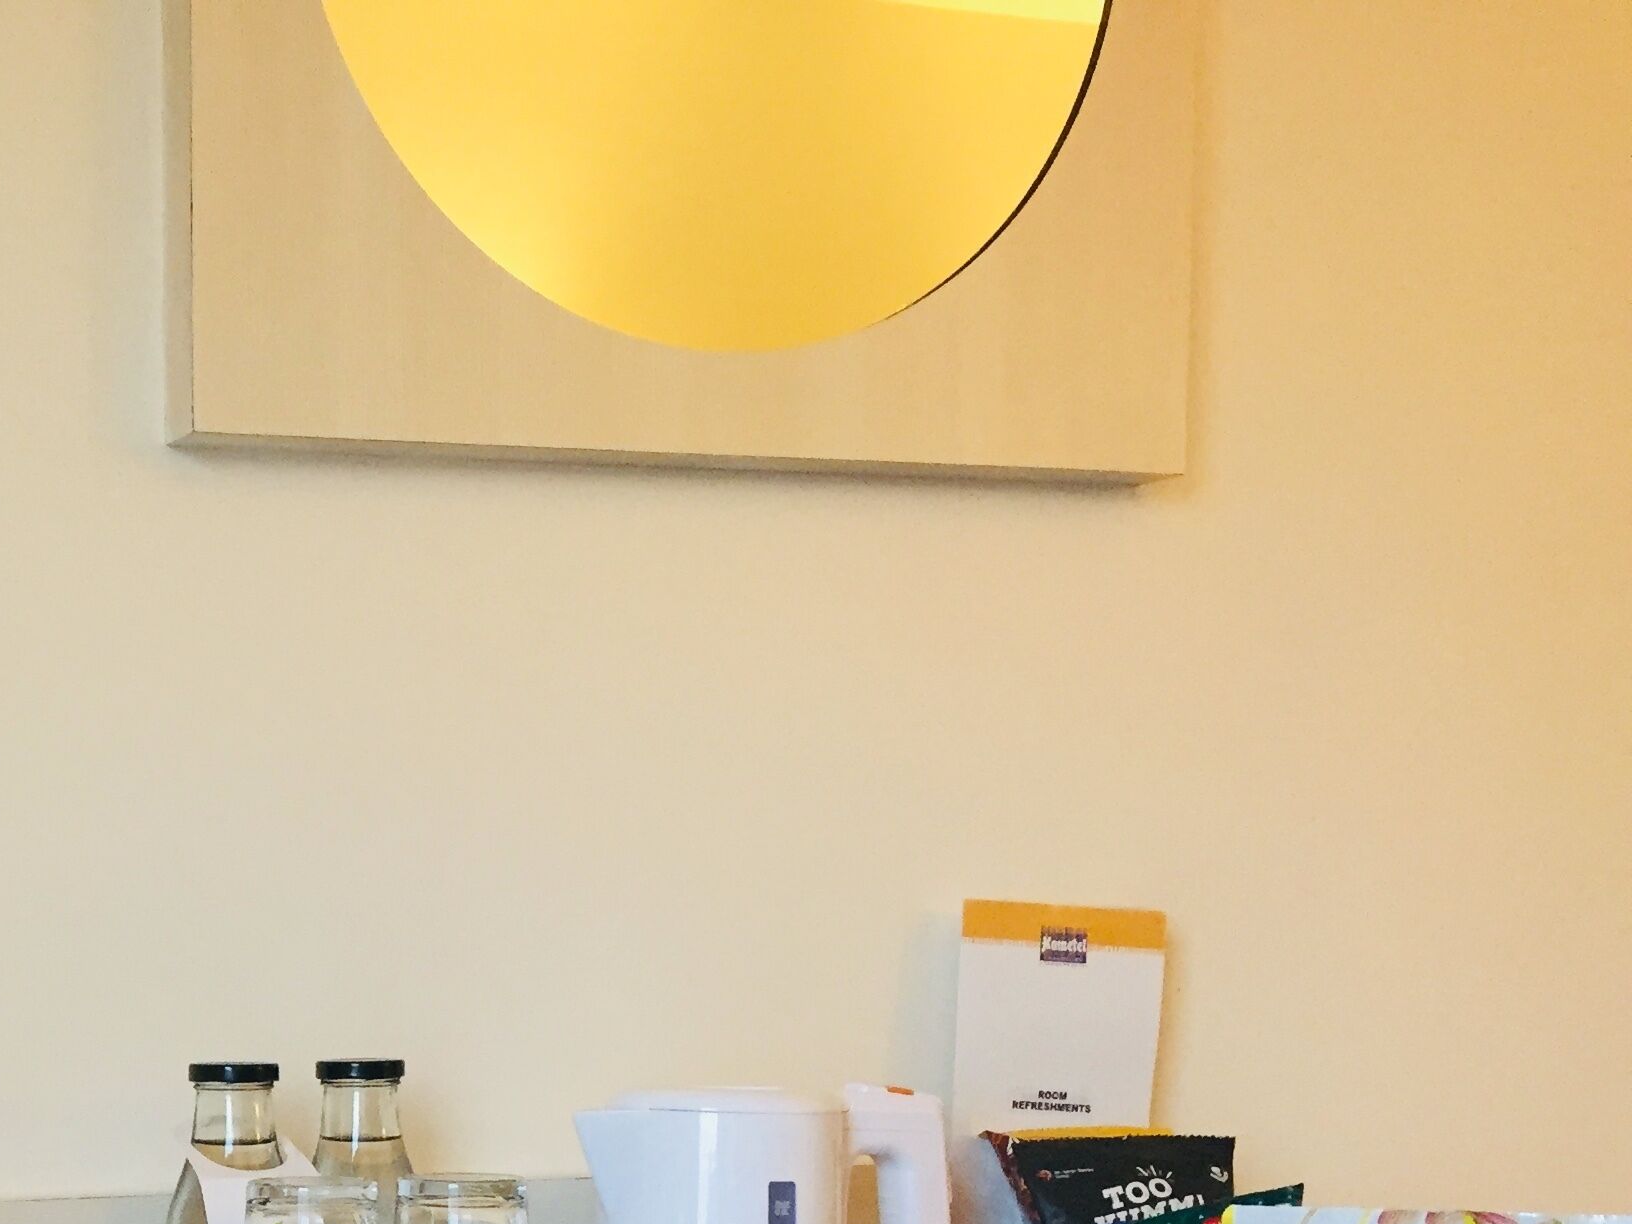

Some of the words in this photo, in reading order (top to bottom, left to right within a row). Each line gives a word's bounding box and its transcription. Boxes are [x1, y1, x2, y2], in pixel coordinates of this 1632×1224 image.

[1038, 1090, 1068, 1101] ROOM
[1011, 1100, 1092, 1114] REFRESHMENTS
[1101, 1177, 1173, 1210] TOO
